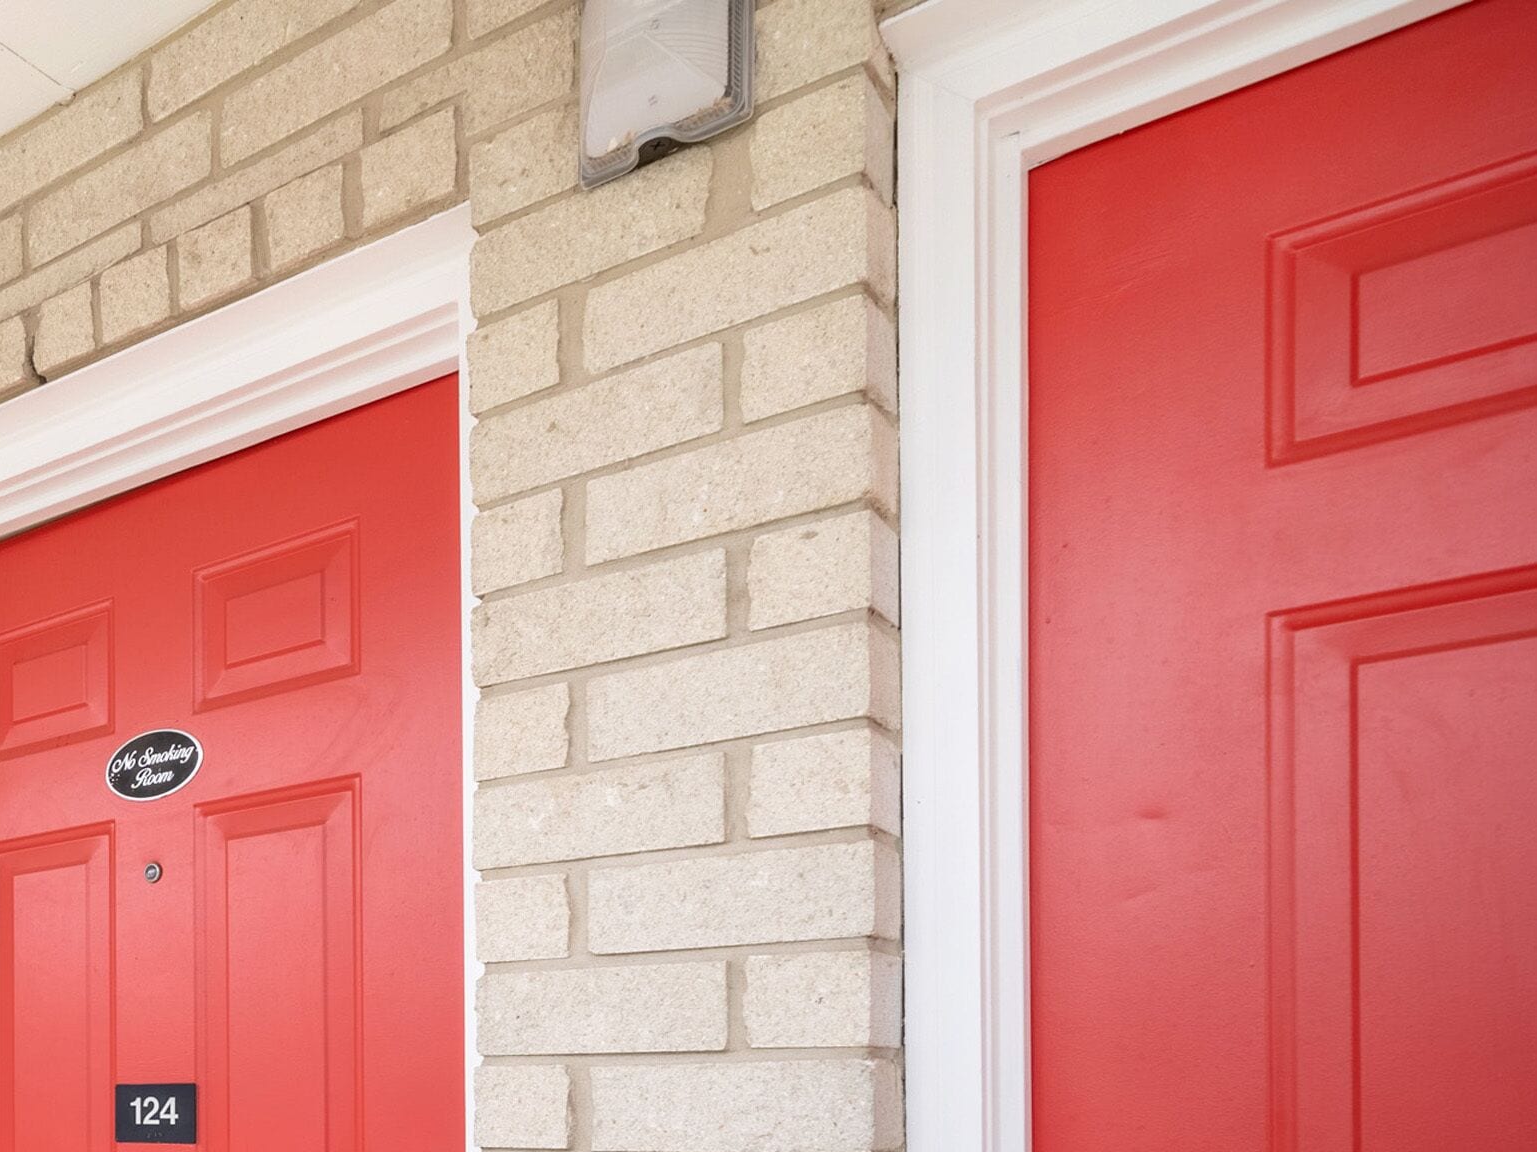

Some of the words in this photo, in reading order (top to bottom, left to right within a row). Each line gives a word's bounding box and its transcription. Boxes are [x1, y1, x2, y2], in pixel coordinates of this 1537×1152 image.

[112, 750, 137, 773] No
[138, 744, 195, 767] Smoking
[131, 768, 174, 789] Room
[129, 1096, 179, 1125] 124
